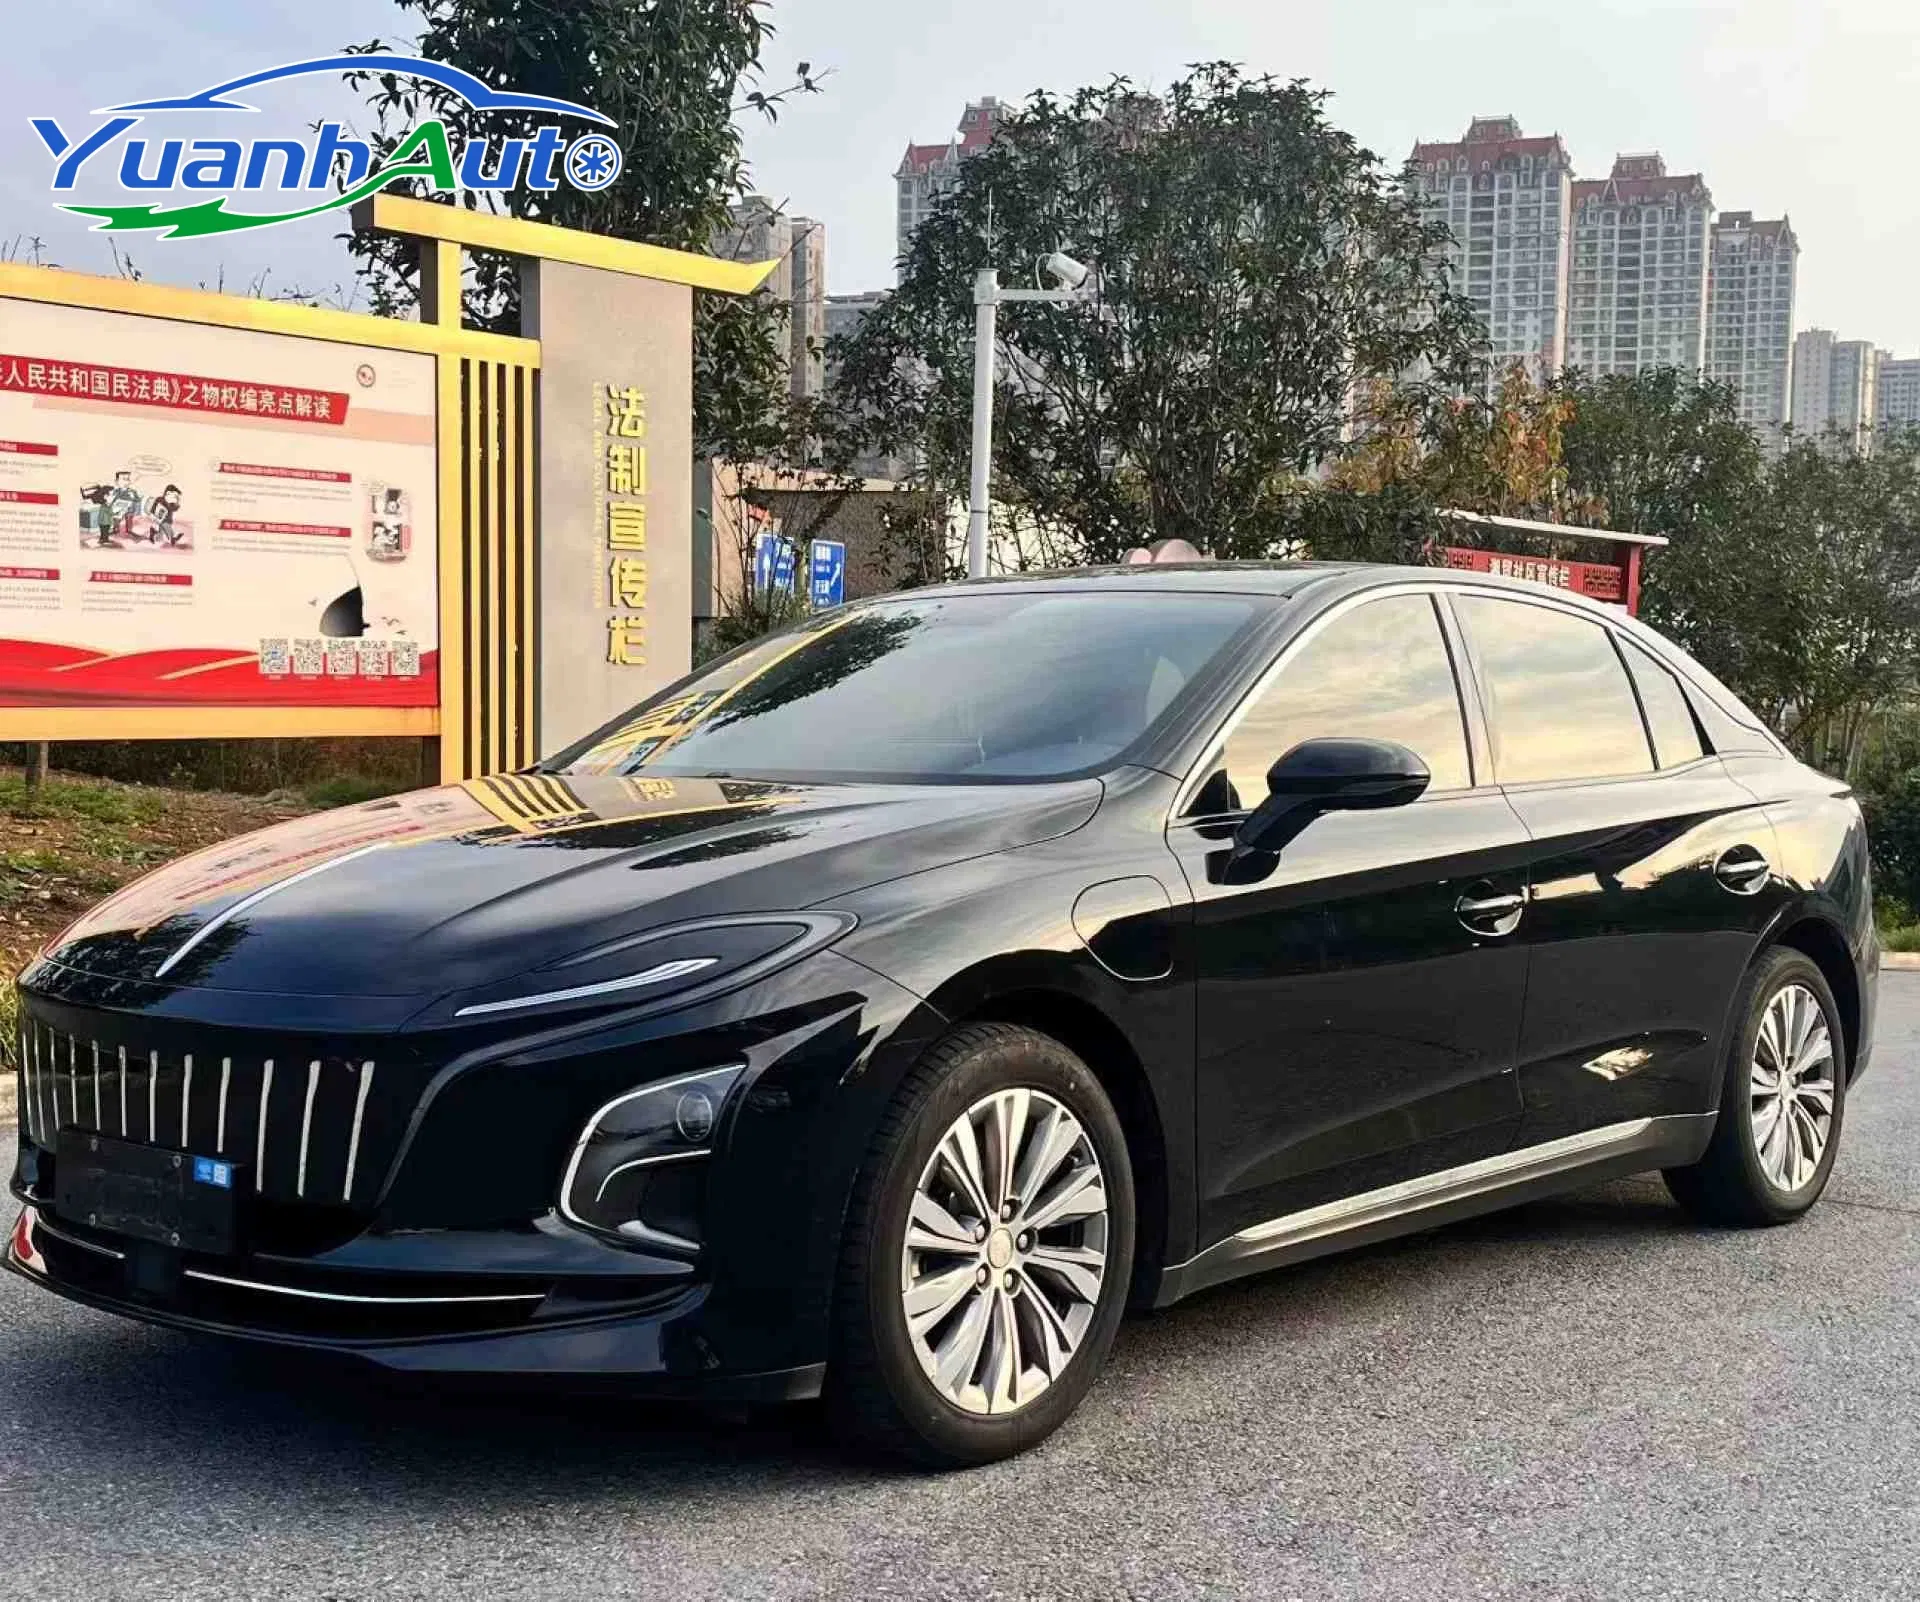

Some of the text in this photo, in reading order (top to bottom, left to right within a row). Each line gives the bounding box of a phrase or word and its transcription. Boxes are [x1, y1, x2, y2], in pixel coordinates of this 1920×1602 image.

[606, 383, 649, 665] 法制宣传栏
